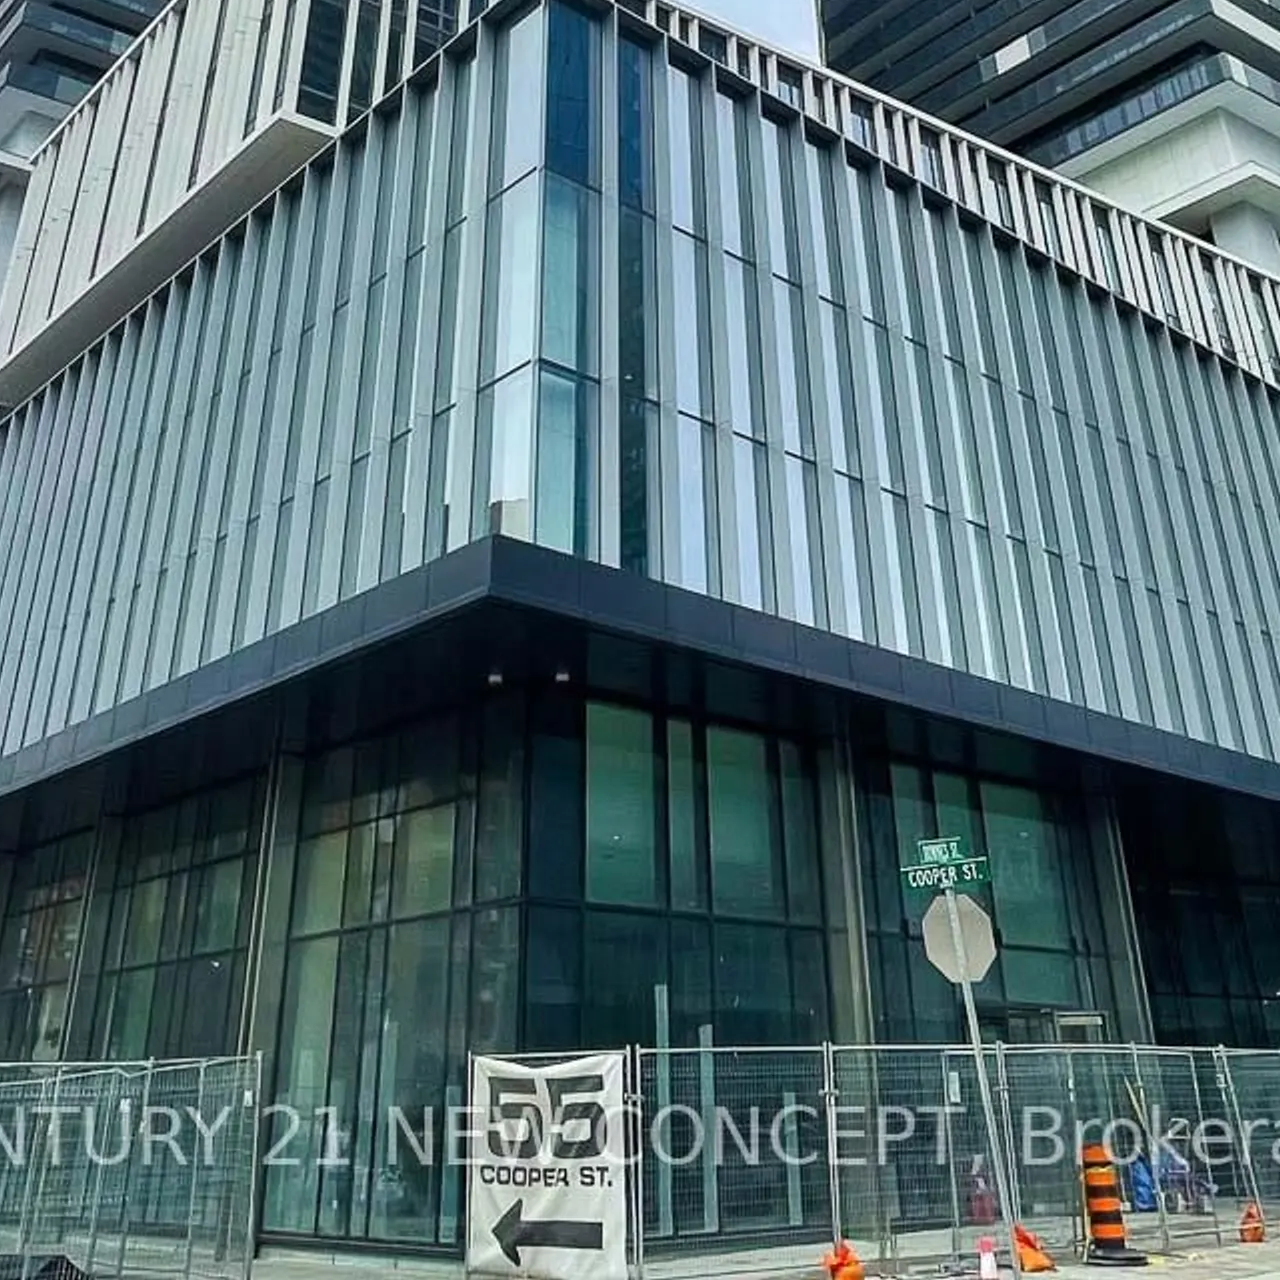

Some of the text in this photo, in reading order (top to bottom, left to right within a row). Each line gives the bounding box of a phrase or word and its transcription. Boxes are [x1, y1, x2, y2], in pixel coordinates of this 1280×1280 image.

[908, 862, 984, 888] COOPER ST.
[488, 1074, 608, 1159] 55
[480, 1165, 613, 1187] COOPER ST.
